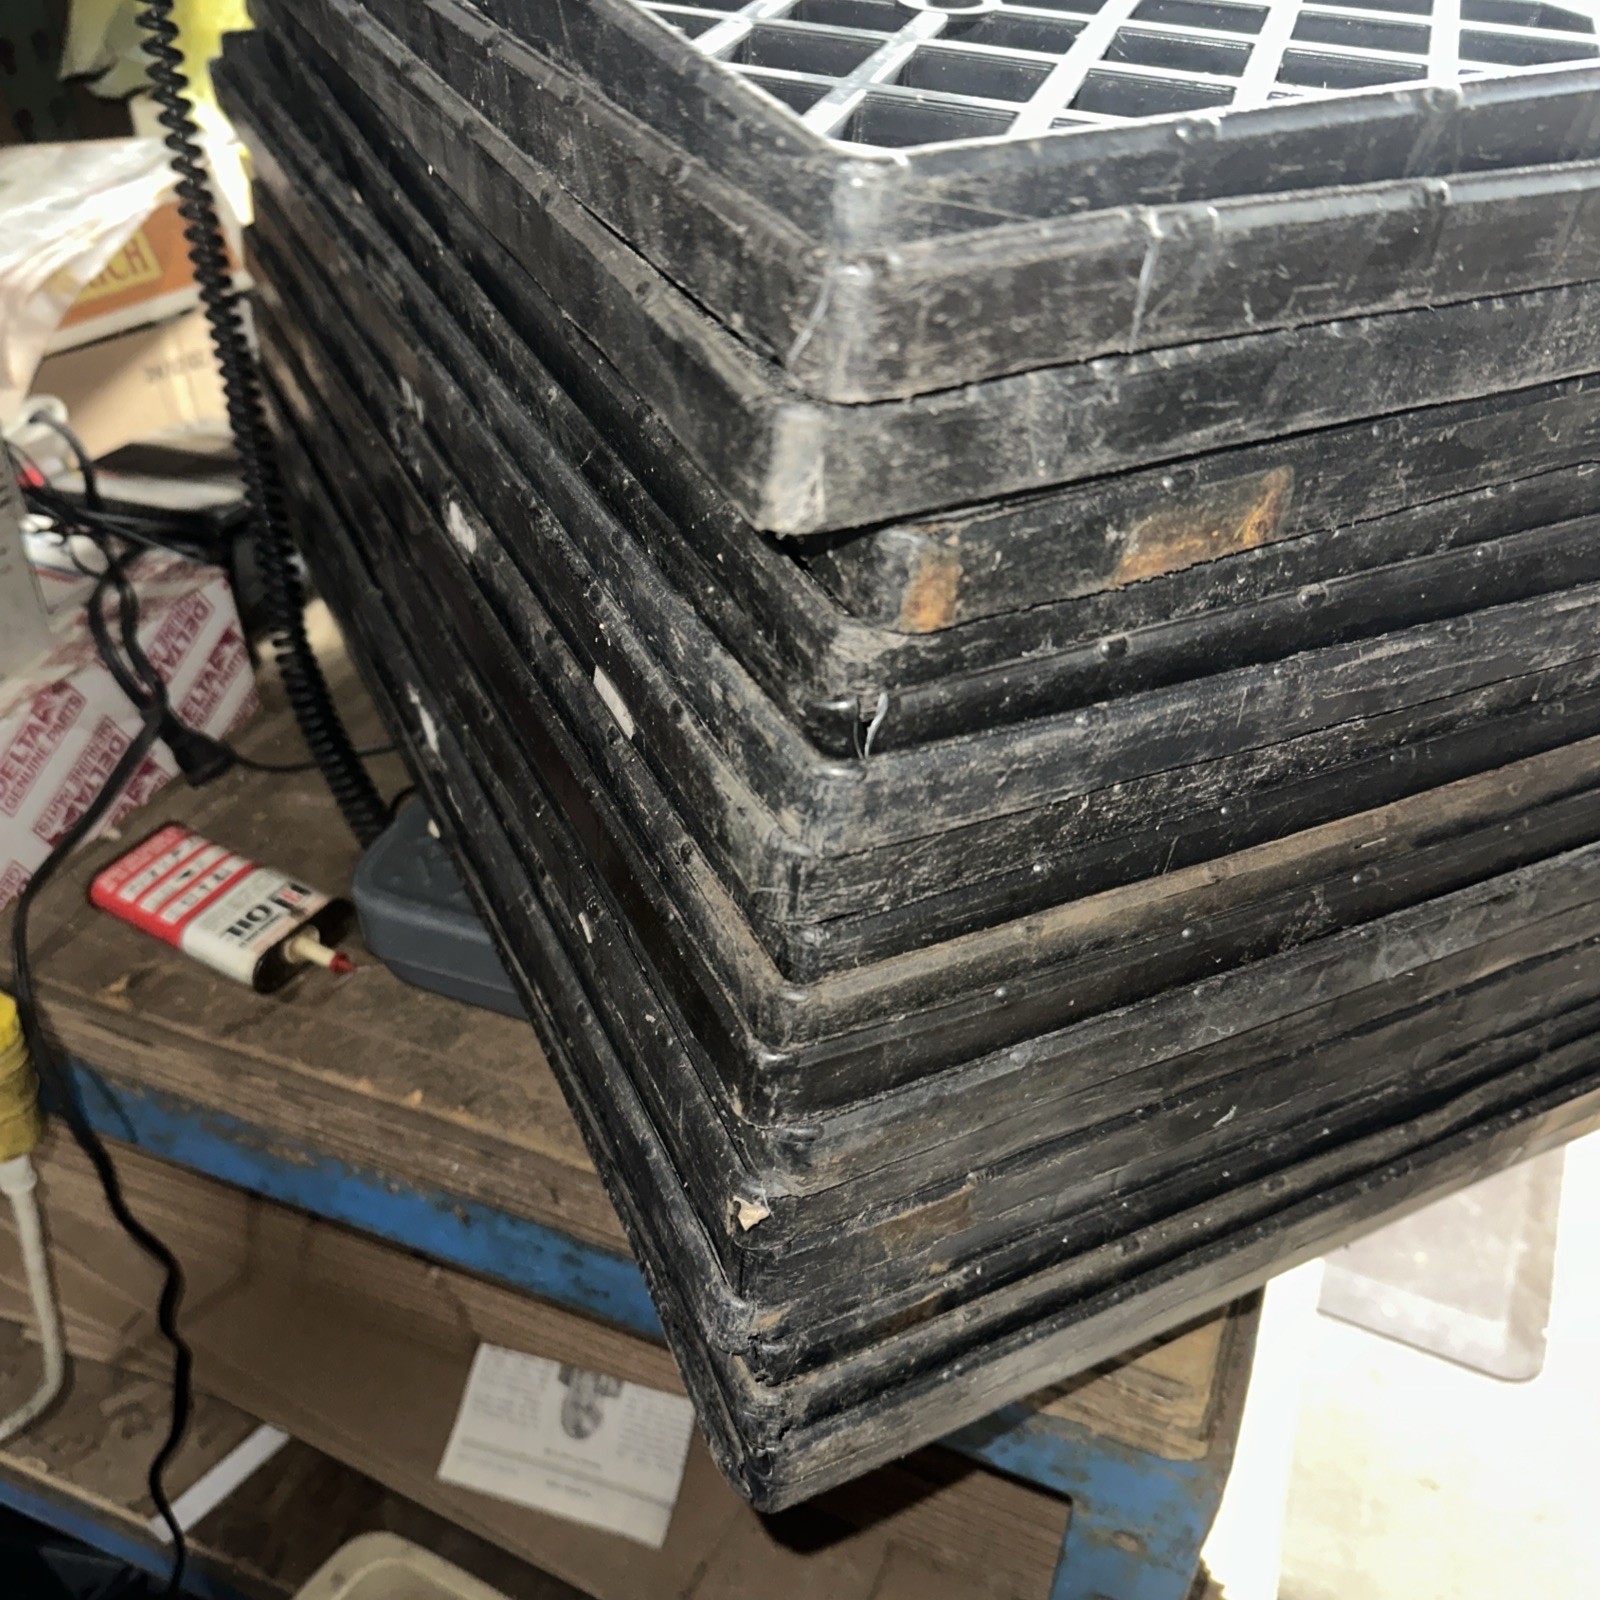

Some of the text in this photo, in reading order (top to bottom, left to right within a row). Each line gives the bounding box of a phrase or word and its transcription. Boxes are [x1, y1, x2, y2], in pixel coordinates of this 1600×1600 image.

[162, 600, 210, 668] DELTA
[178, 670, 218, 724] ELTA
[5, 695, 82, 809] GENUINE PARTS
[37, 718, 113, 834] GENUINE PARTS
[74, 735, 127, 806] DELTA
[222, 904, 272, 937] OIL
